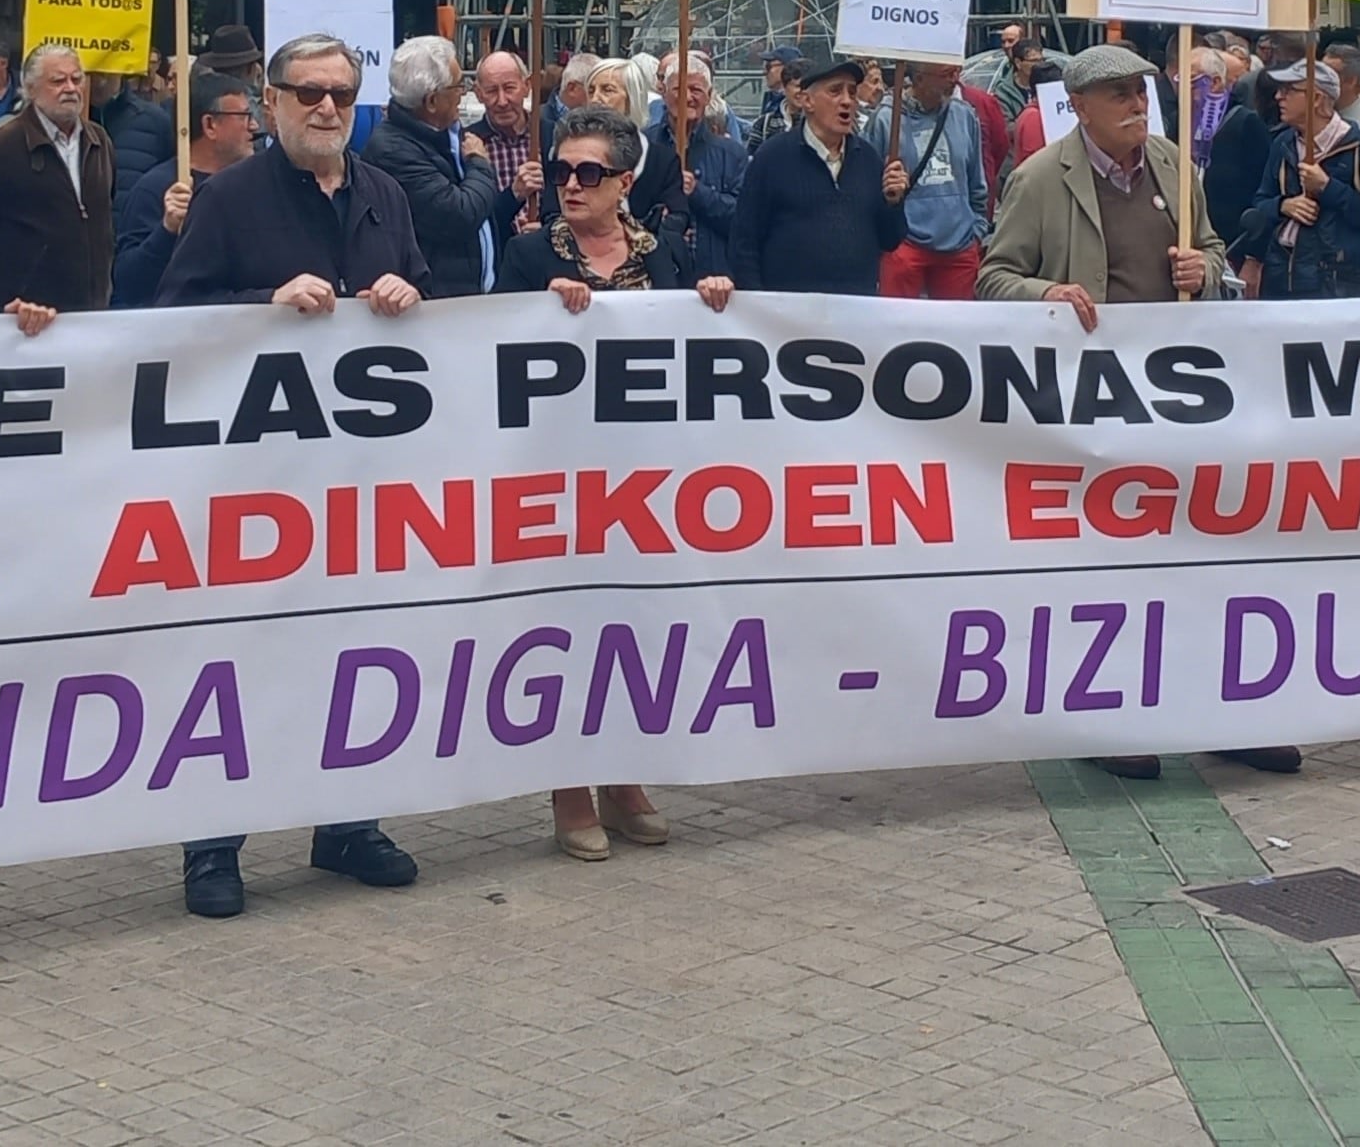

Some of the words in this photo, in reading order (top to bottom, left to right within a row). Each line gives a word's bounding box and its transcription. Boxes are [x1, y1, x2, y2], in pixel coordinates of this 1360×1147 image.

[871, 6, 939, 26] DIGNOS
[131, 345, 433, 450] LAS
[497, 338, 1235, 429] PERSONAS
[89, 462, 955, 598] ADINEKOEN
[320, 617, 778, 772] DIGNA
[839, 669, 879, 692] -
[935, 600, 1164, 720] BIZI
